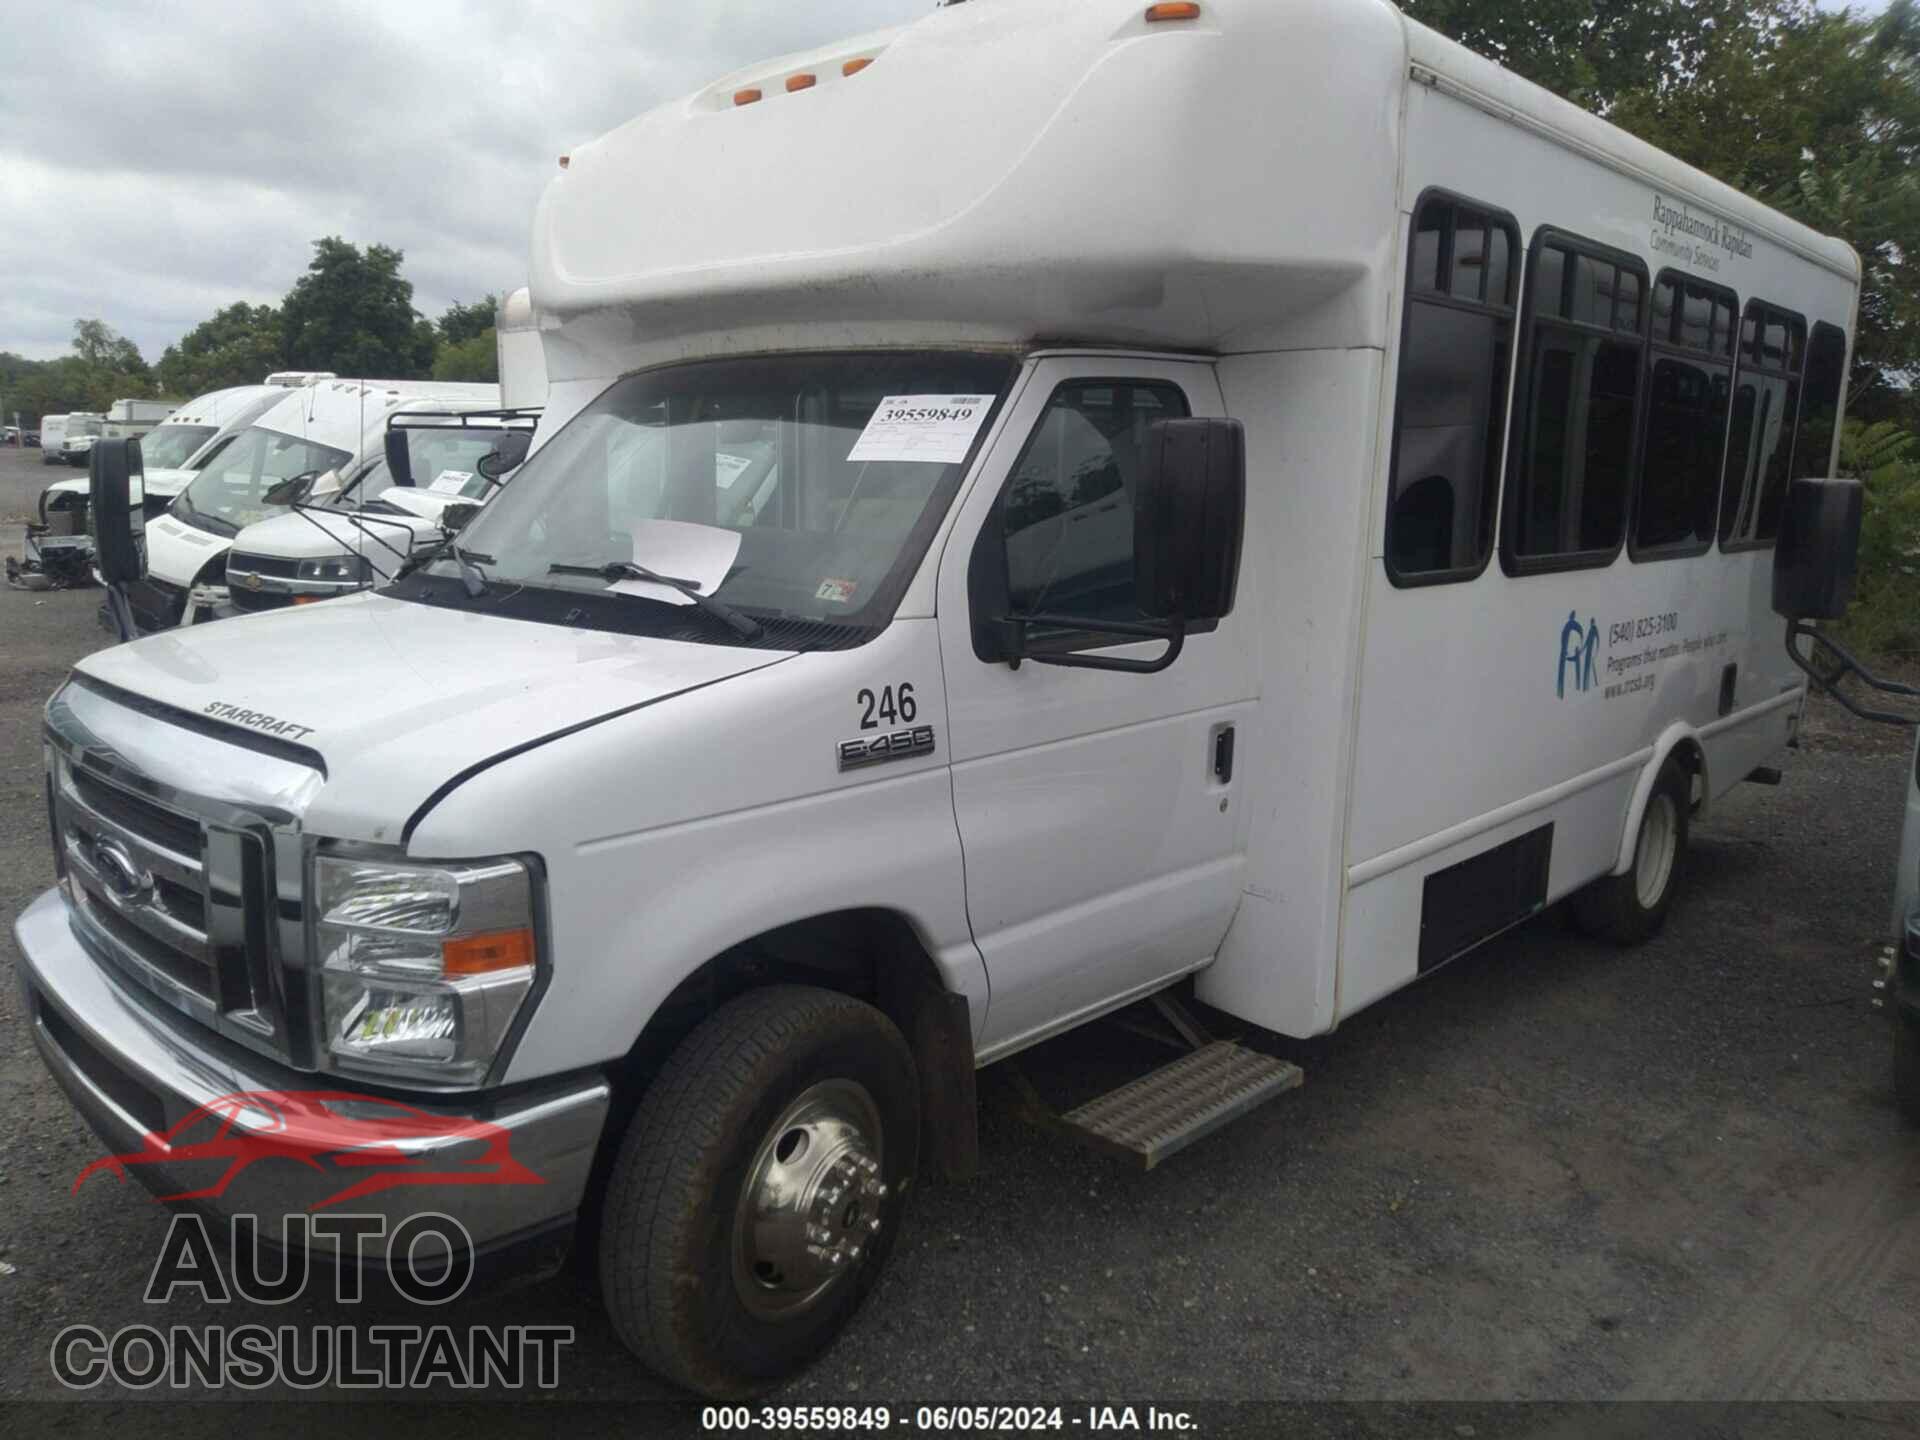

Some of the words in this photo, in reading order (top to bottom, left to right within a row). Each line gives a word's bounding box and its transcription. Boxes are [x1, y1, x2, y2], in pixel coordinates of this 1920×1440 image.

[1653, 195, 1720, 245] Rappahannock
[1650, 229, 1693, 266] Community
[880, 407, 973, 423] 39559849
[1609, 618, 1634, 648] (540)
[1635, 611, 1679, 639] 825-3100
[1607, 654, 1642, 677] Programs
[203, 701, 316, 740] STARCRAFT
[857, 682, 917, 730] 246
[840, 729, 934, 760] E-450
